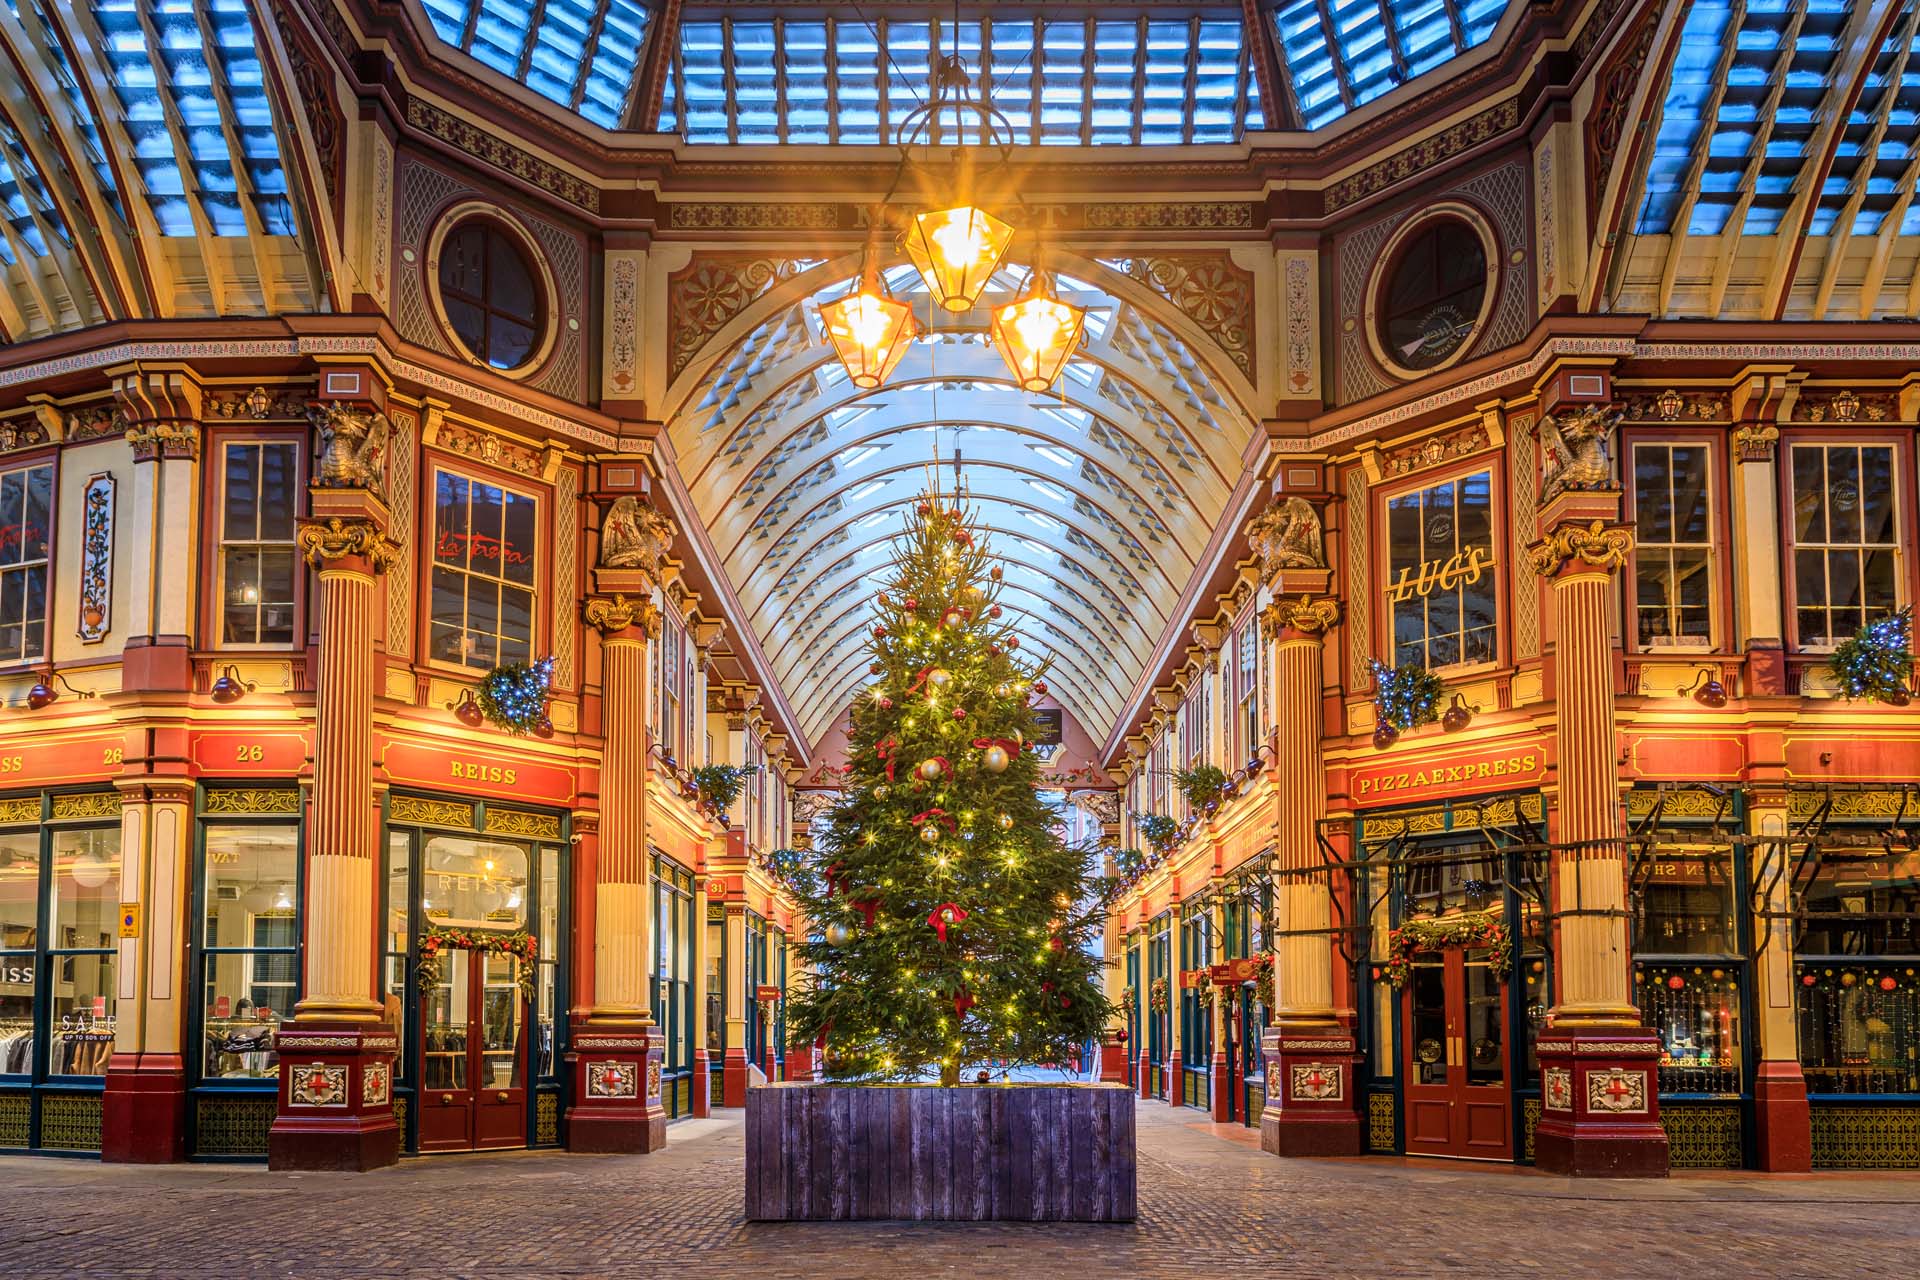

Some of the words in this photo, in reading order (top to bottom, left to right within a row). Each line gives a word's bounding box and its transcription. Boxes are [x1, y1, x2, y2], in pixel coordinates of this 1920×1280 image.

[1393, 545, 1485, 603] LUC'S
[103, 748, 123, 765] 26
[236, 744, 263, 762] 26
[450, 760, 516, 785] REISS
[1359, 754, 1537, 794] PIZZAEXPRESS
[438, 874, 514, 894] REISS
[711, 883, 723, 893] 31
[62, 1015, 116, 1031] SALE
